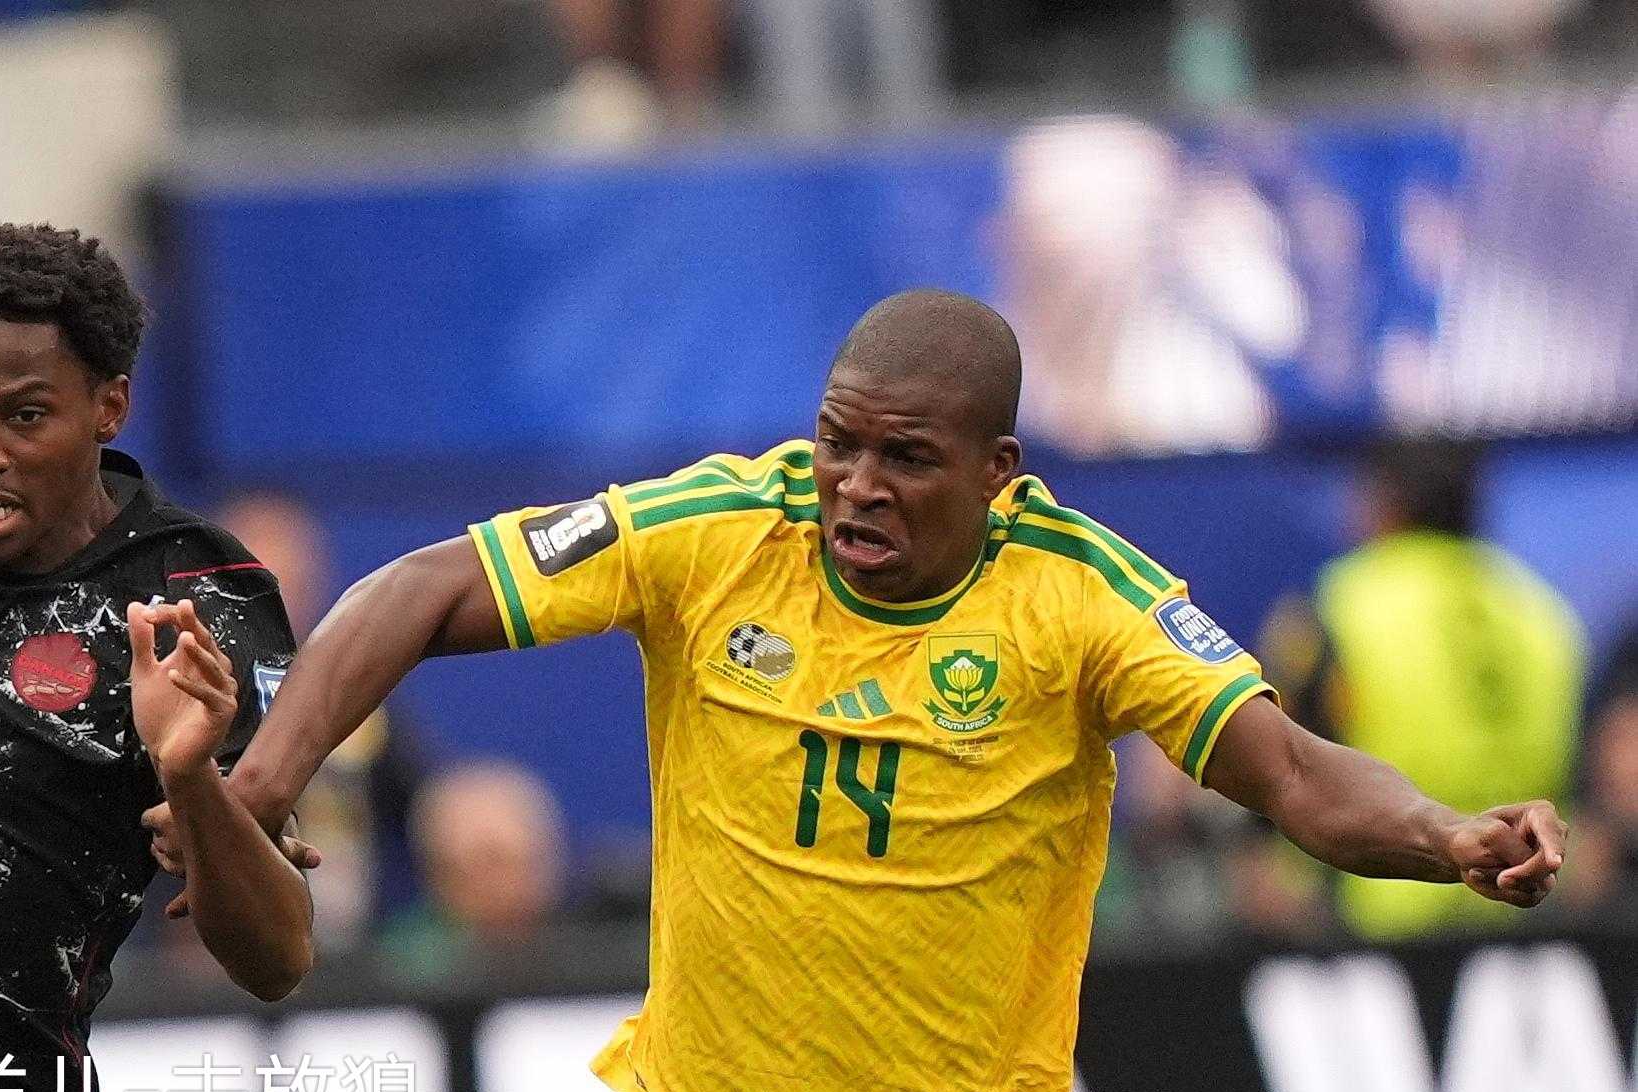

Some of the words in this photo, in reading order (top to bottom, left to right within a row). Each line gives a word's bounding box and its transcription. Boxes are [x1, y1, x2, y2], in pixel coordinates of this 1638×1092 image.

[937, 716, 964, 731] SOUTH
[964, 715, 994, 731] AFRICA
[795, 729, 901, 858] 14
